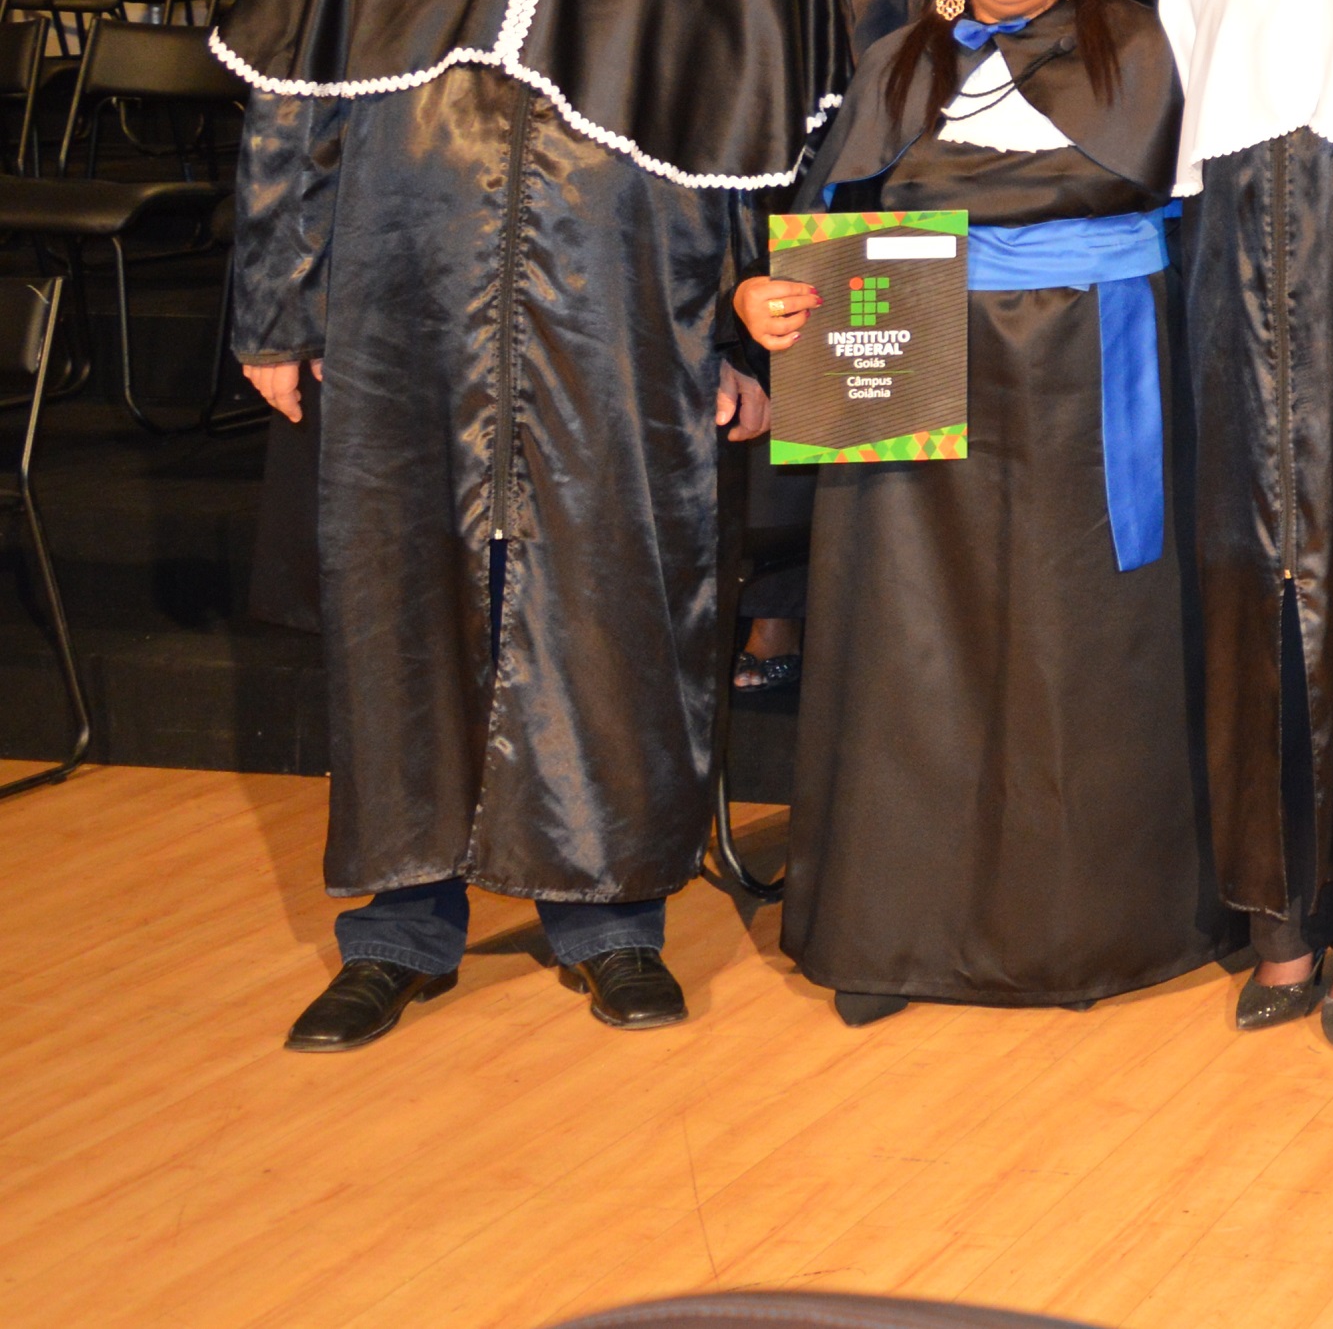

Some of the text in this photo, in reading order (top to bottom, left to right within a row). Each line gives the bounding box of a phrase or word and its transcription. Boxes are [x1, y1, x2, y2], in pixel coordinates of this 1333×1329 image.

[828, 330, 911, 344] INSTITUTO
[835, 343, 903, 356] FEDERAL
[853, 357, 886, 369] Goiás
[847, 376, 893, 388] Câmpus
[848, 388, 891, 399] Goiânia
